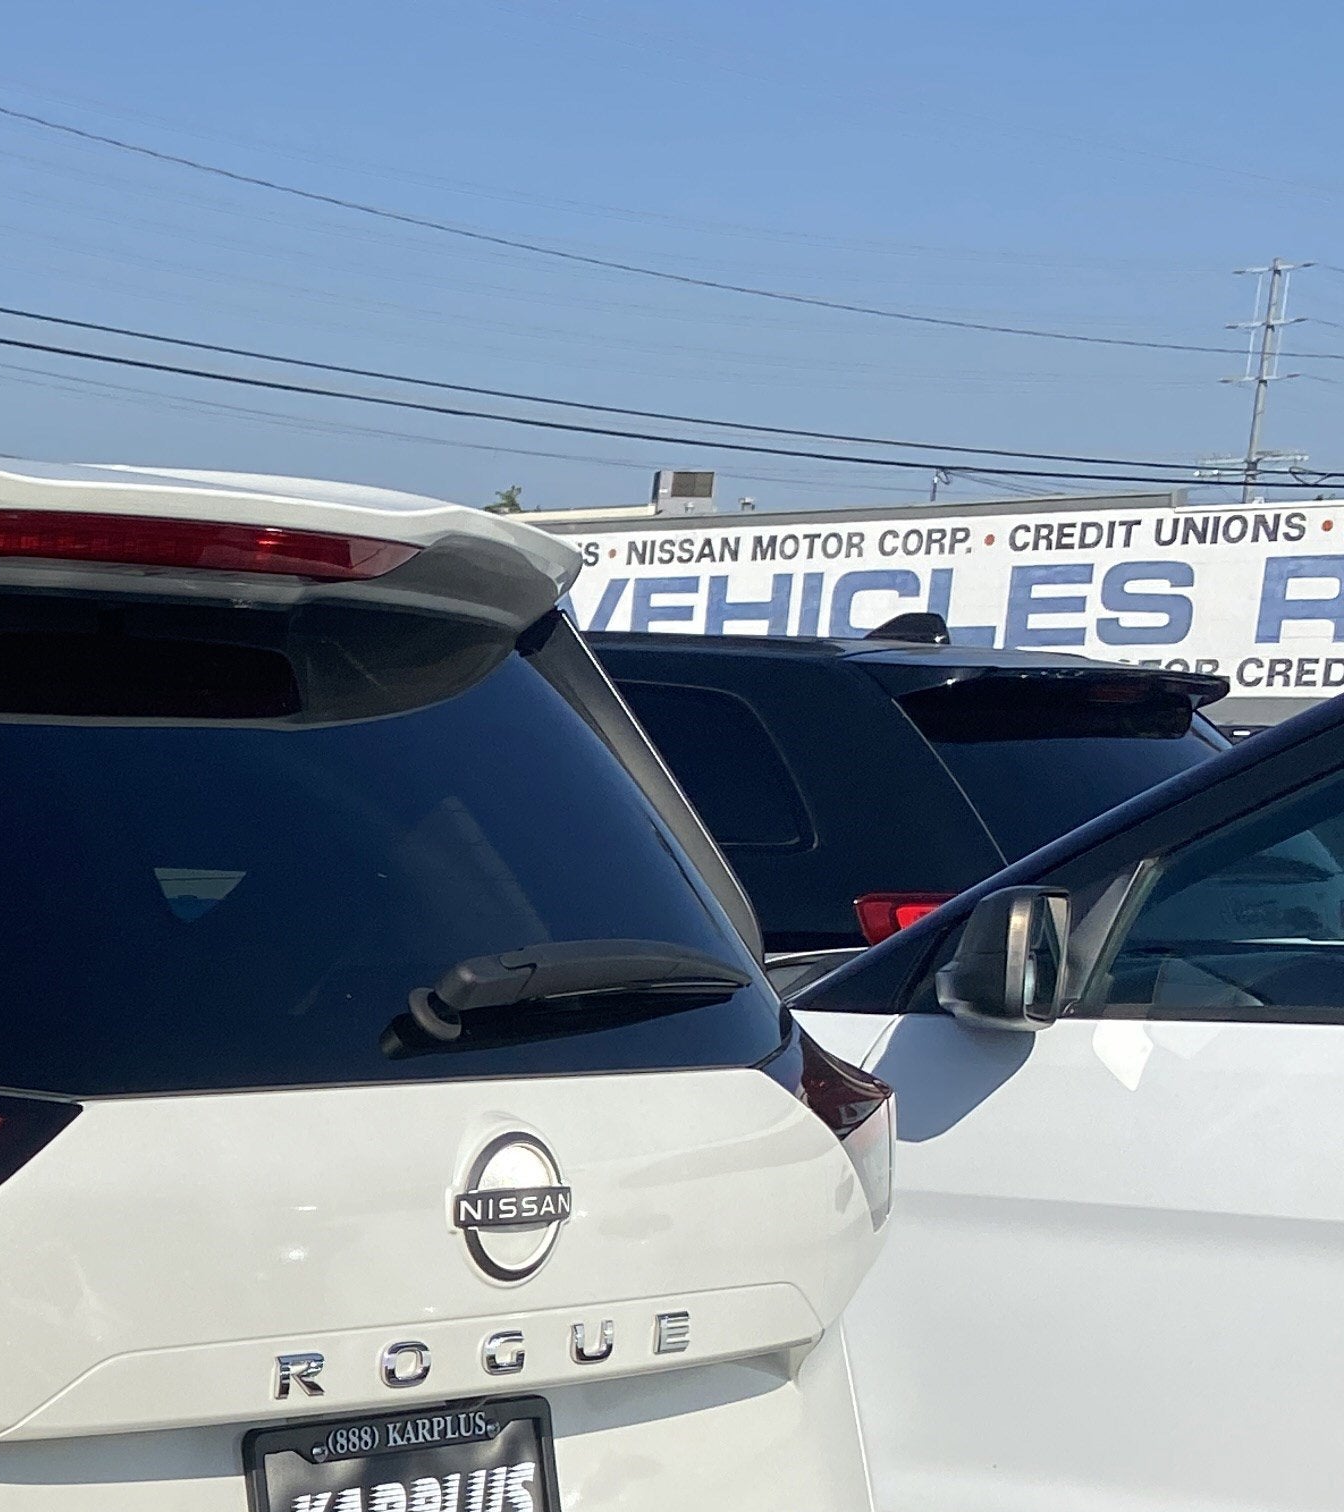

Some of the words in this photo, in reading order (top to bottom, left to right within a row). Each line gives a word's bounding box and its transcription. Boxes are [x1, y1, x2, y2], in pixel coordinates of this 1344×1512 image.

[625, 536, 742, 566] NISSAN
[750, 531, 866, 562] MOTOR
[878, 526, 973, 557] CORP.
[1009, 519, 1142, 552] CREDIT
[1154, 512, 1307, 547] UNIONS
[554, 559, 1195, 649] VEHICLES
[459, 1190, 571, 1222] NISSAN
[273, 1309, 693, 1401] ROGUE
[326, 1425, 380, 1456] (888)
[386, 1412, 489, 1449] KARPLUS
